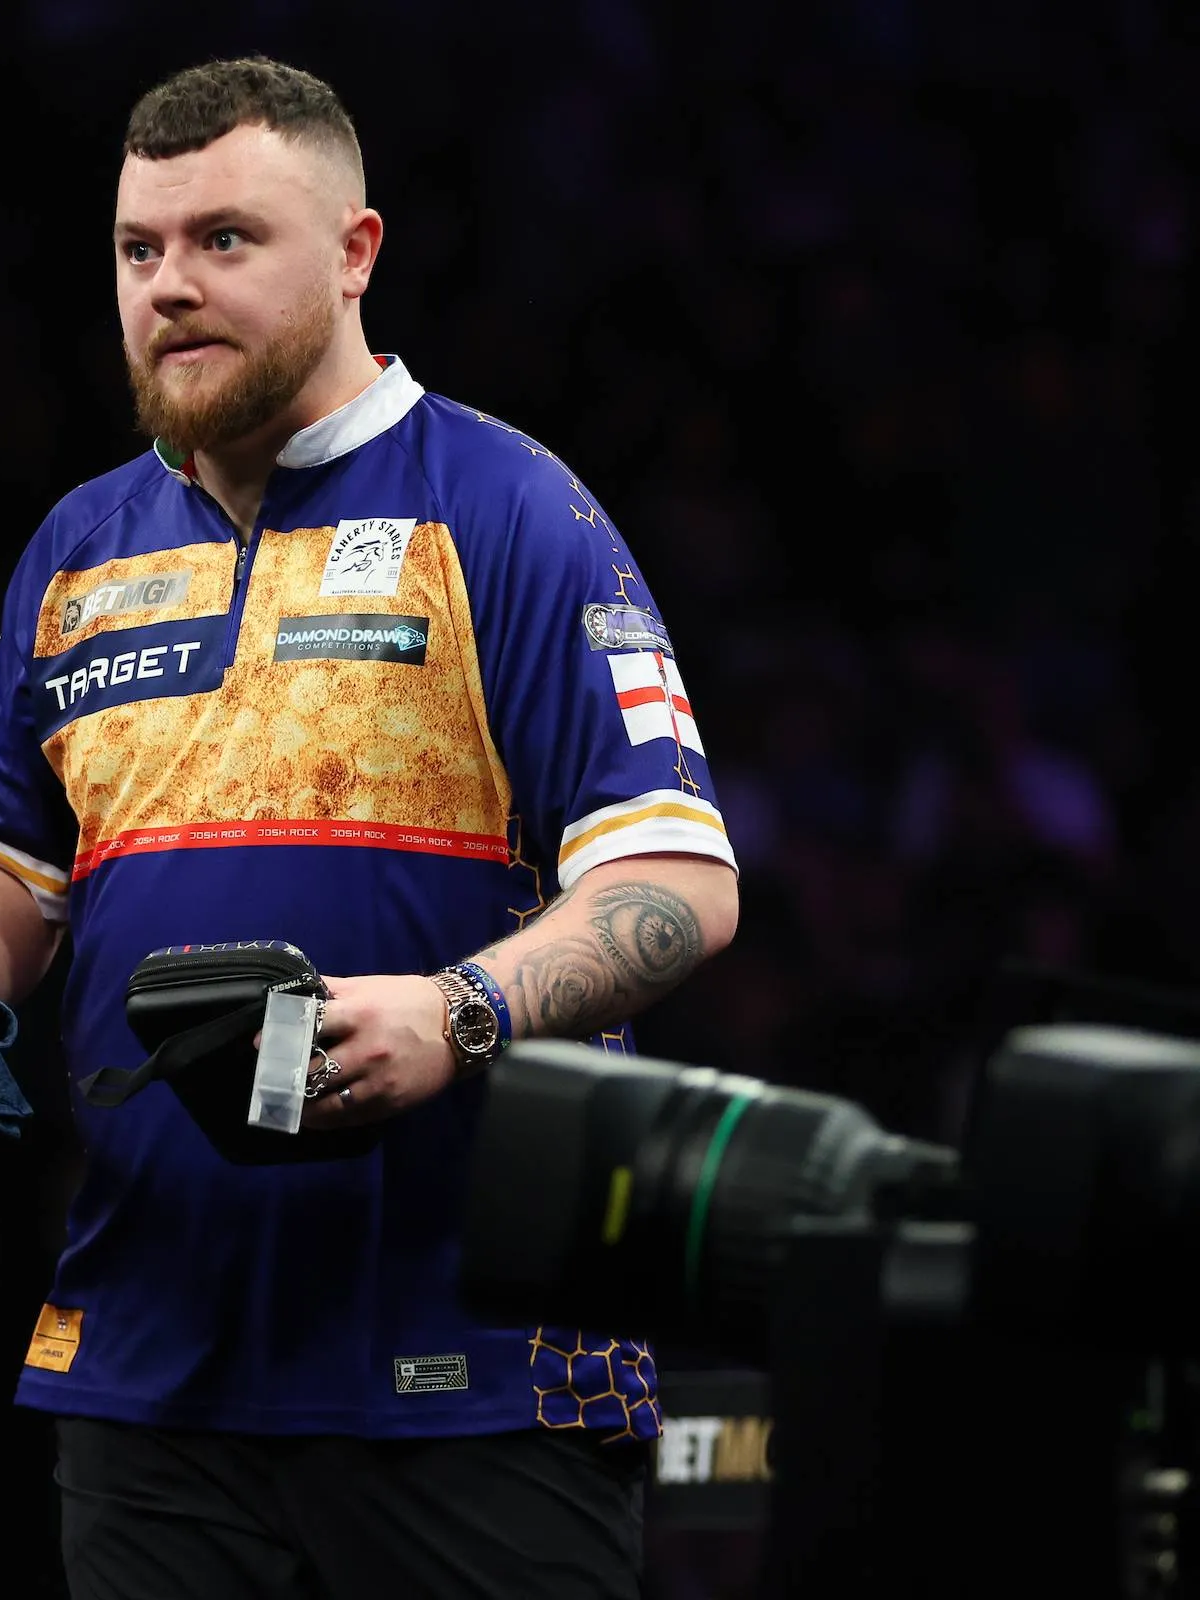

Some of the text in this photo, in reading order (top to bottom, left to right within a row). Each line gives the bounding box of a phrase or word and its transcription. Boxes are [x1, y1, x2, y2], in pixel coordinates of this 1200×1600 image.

[331, 520, 402, 562] CAHERTY STABLES
[277, 628, 411, 645] DIAMOND DRAWS
[297, 642, 380, 651] COMPETITIONS
[45, 641, 201, 711] TARGET
[133, 837, 154, 846] JOSH
[158, 832, 180, 843] ROCK
[189, 831, 218, 840] JOSH
[221, 829, 247, 839] ROCK
[257, 828, 286, 837] JOSH
[289, 828, 319, 837] ROCK
[330, 829, 361, 838] JOSH
[364, 830, 386, 840] ROCK
[397, 833, 426, 844] JOSH
[428, 837, 453, 847] ROCK
[463, 841, 489, 851] JOSH
